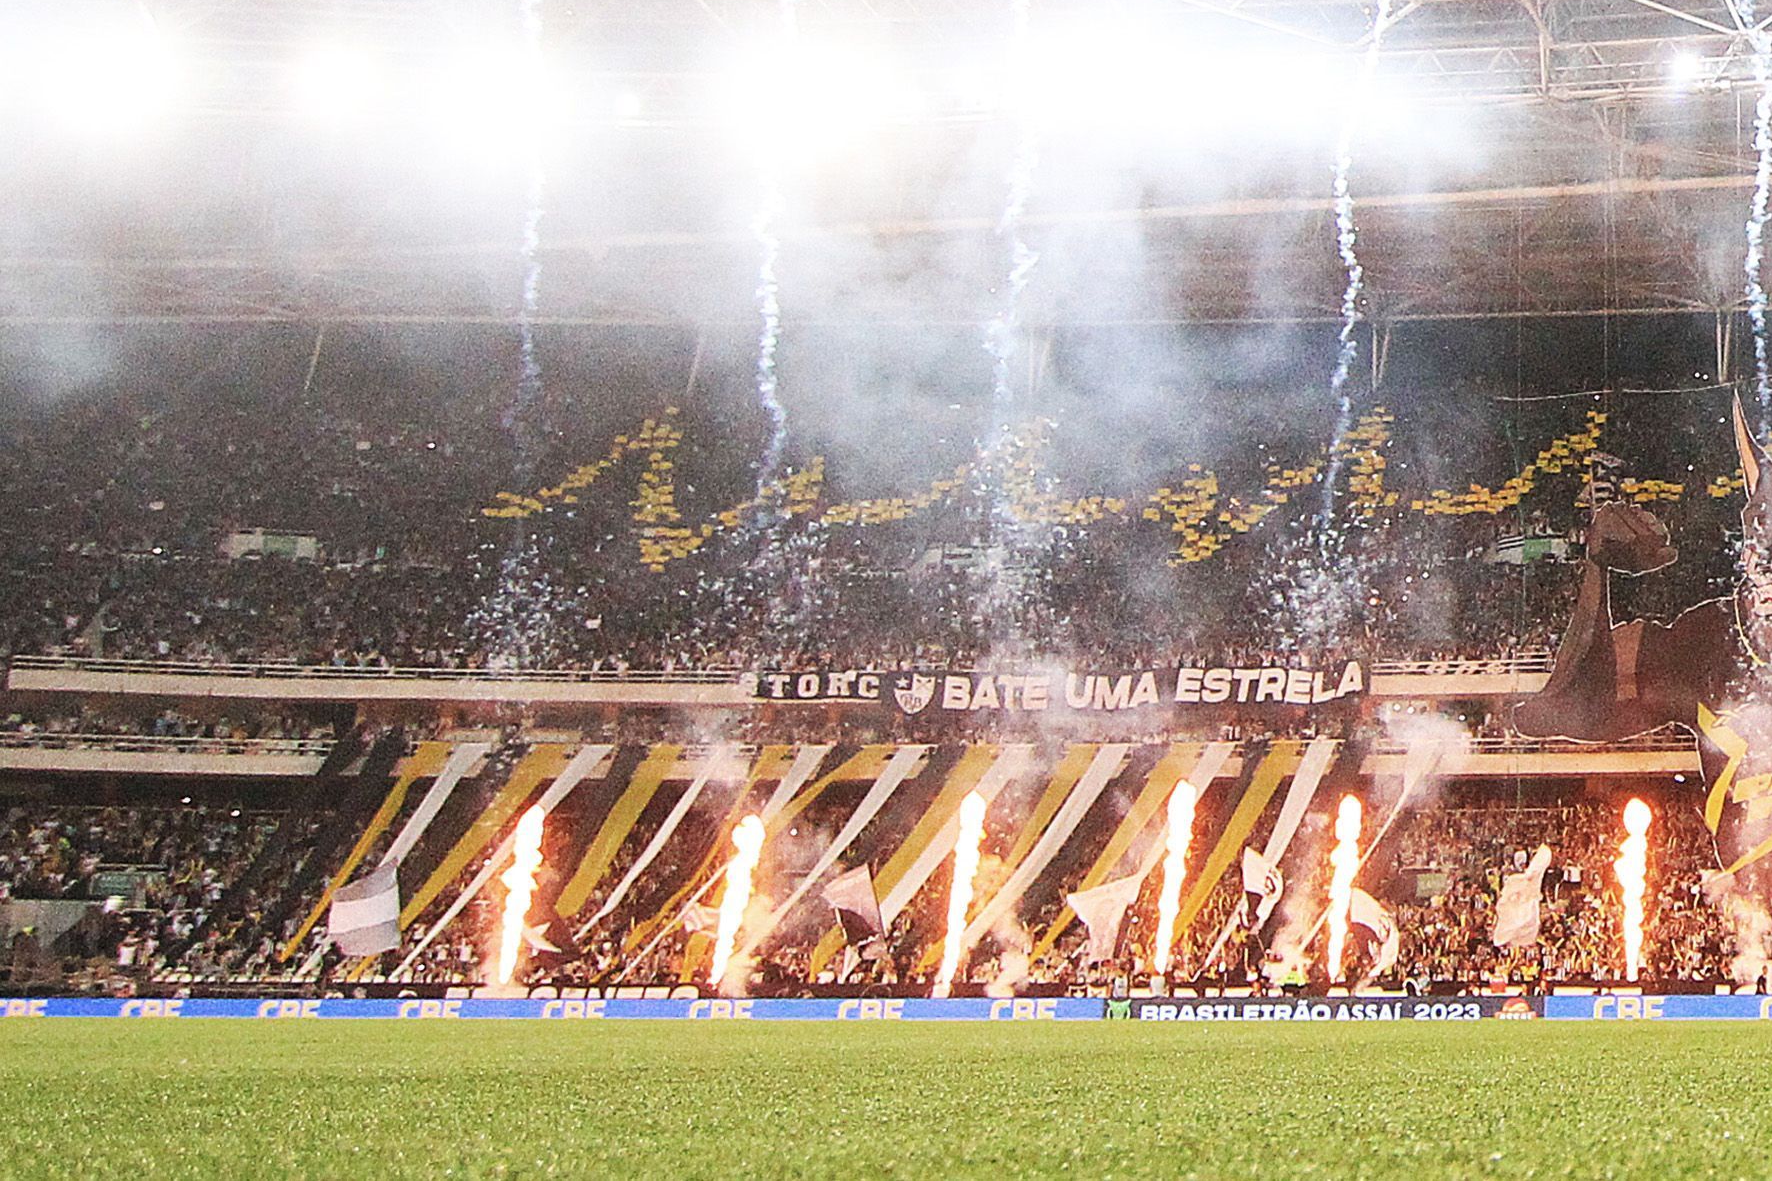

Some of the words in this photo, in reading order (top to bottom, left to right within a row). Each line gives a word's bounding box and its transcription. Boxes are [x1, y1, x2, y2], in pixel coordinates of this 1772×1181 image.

[942, 675, 1049, 711] BATE
[1065, 671, 1159, 711] UMA
[1174, 661, 1363, 704] ESTRELA
[0, 999, 47, 1017] BF
[1413, 1003, 1481, 1020] 2023
